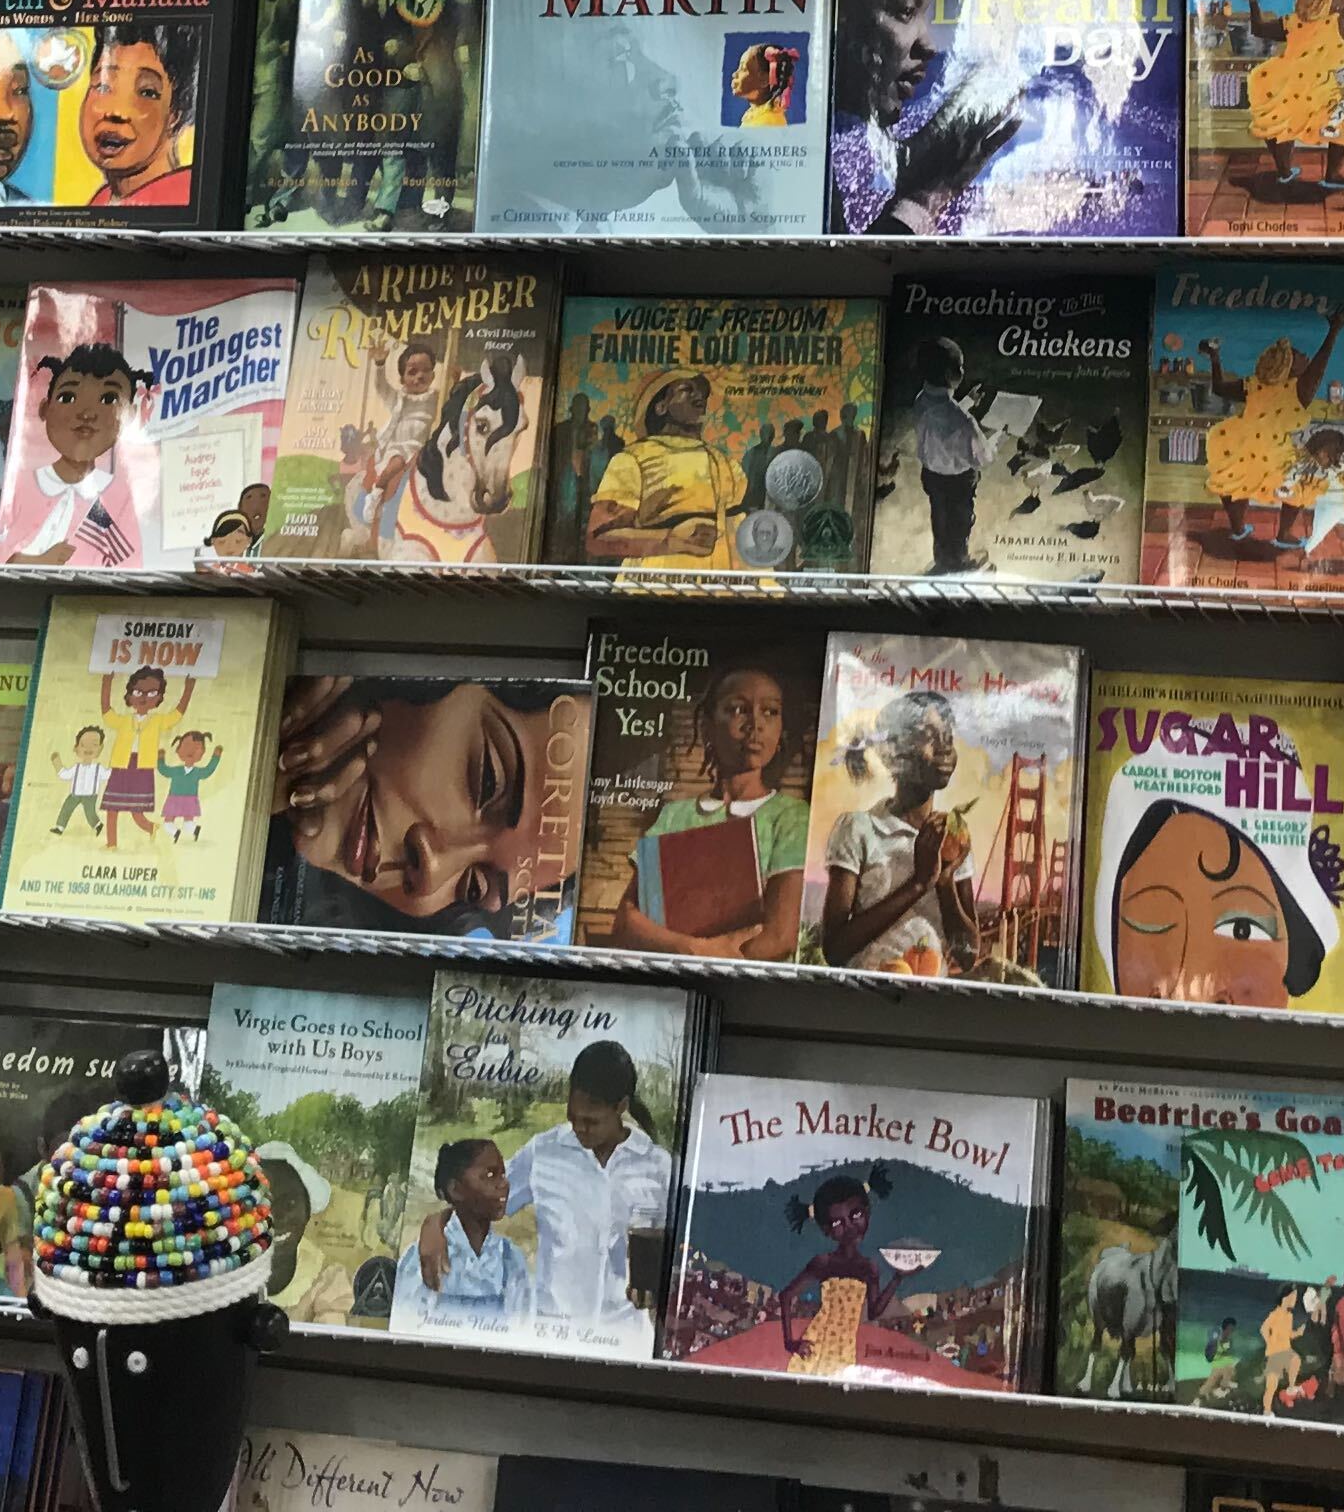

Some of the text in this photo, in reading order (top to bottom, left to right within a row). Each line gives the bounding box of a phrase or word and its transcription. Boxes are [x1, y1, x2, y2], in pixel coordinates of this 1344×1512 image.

[503, 209, 655, 223] CHRISTINE KING FARRIS
[904, 284, 1055, 328] Preaching
[176, 317, 220, 347] The
[997, 325, 1132, 358] Chickens
[148, 323, 281, 378] Youngest
[588, 334, 842, 365] FANNIE LOU HAMER
[160, 354, 281, 421] Marcher
[124, 623, 194, 638] SOMEDAY
[111, 640, 202, 666] IS NOW
[597, 634, 709, 667] Freedom
[596, 668, 692, 702] School,
[615, 708, 665, 738] Yes!
[82, 865, 158, 881] CLARA LUPER
[233, 1008, 422, 1043] Virgie Goes to School
[268, 1038, 383, 1064] with Us Boys
[1094, 1097, 1262, 1132] Beatrice's
[720, 1100, 1010, 1175] The Market Bowl
